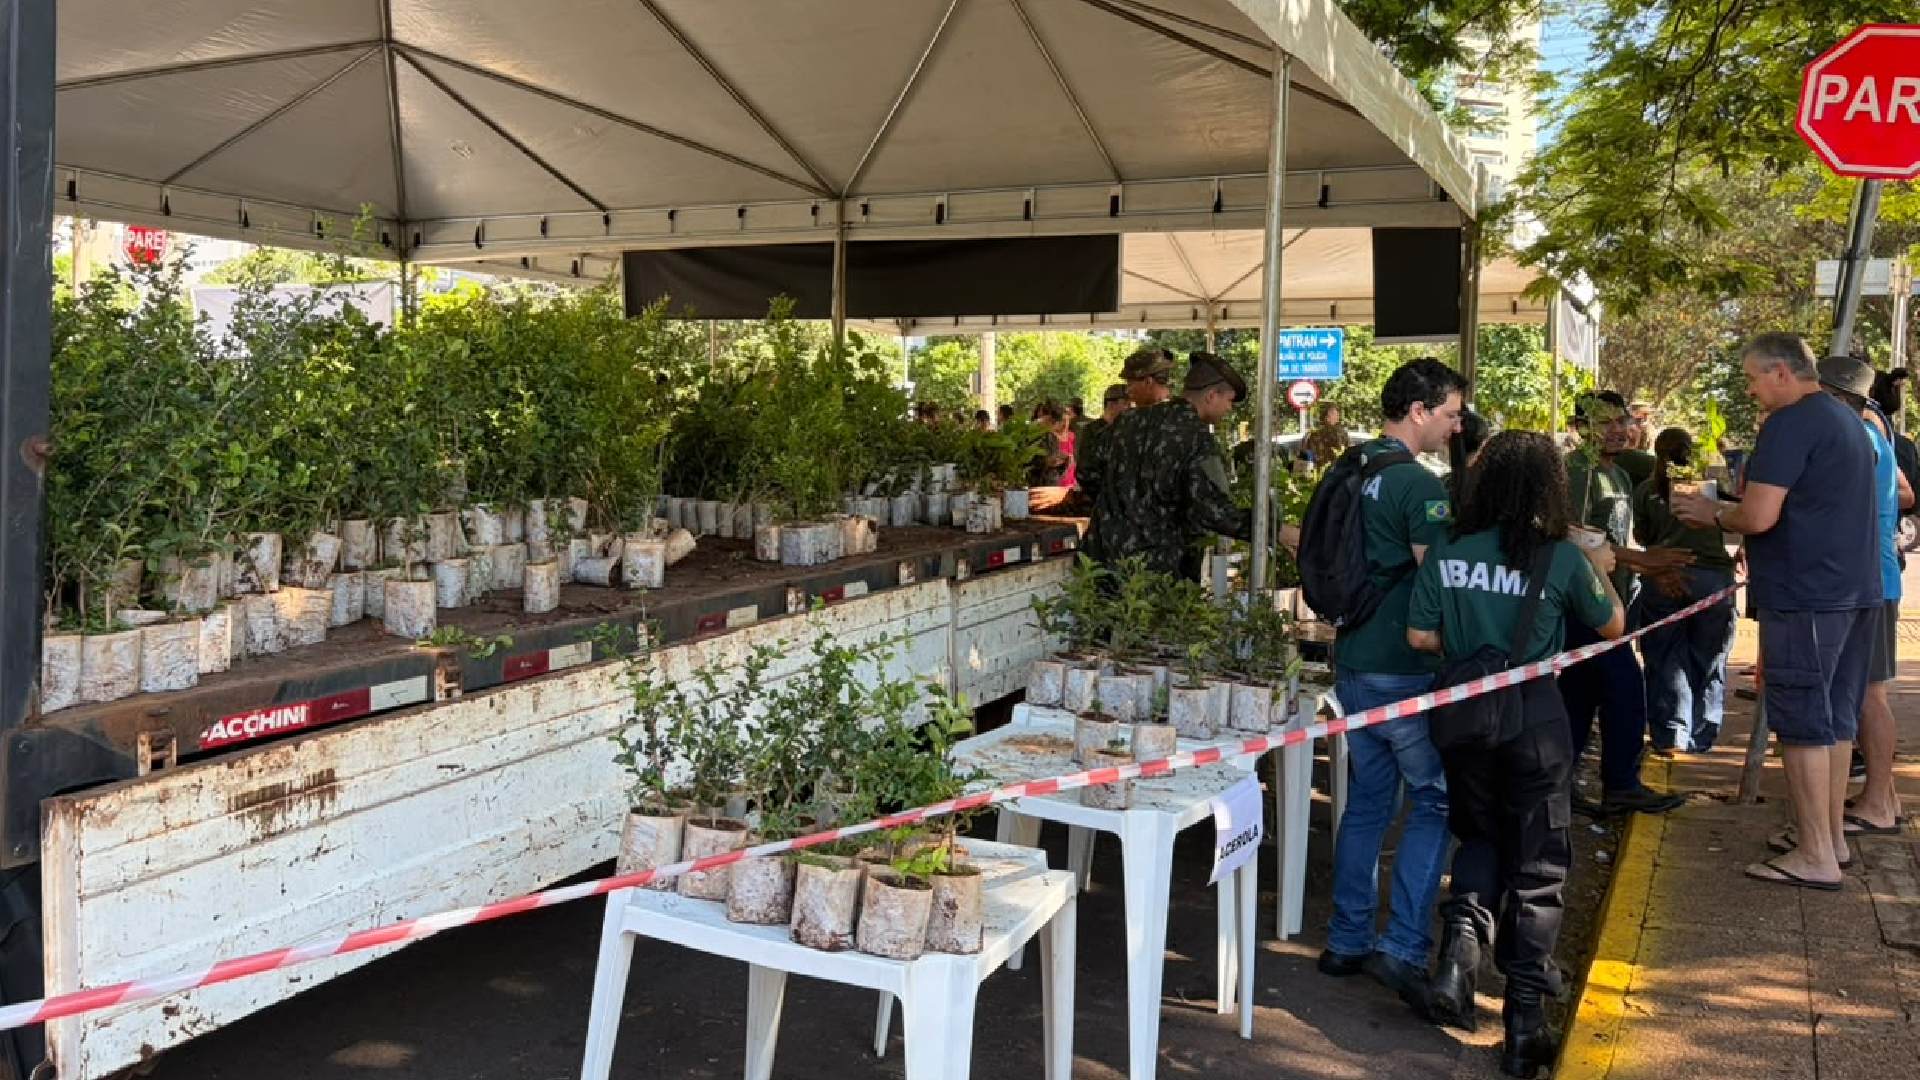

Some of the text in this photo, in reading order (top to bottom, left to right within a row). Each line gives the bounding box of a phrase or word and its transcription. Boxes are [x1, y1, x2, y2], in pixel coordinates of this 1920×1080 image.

[1813, 74, 1920, 123] PAR
[128, 230, 163, 250] PARE
[201, 703, 307, 741] ACCHINI
